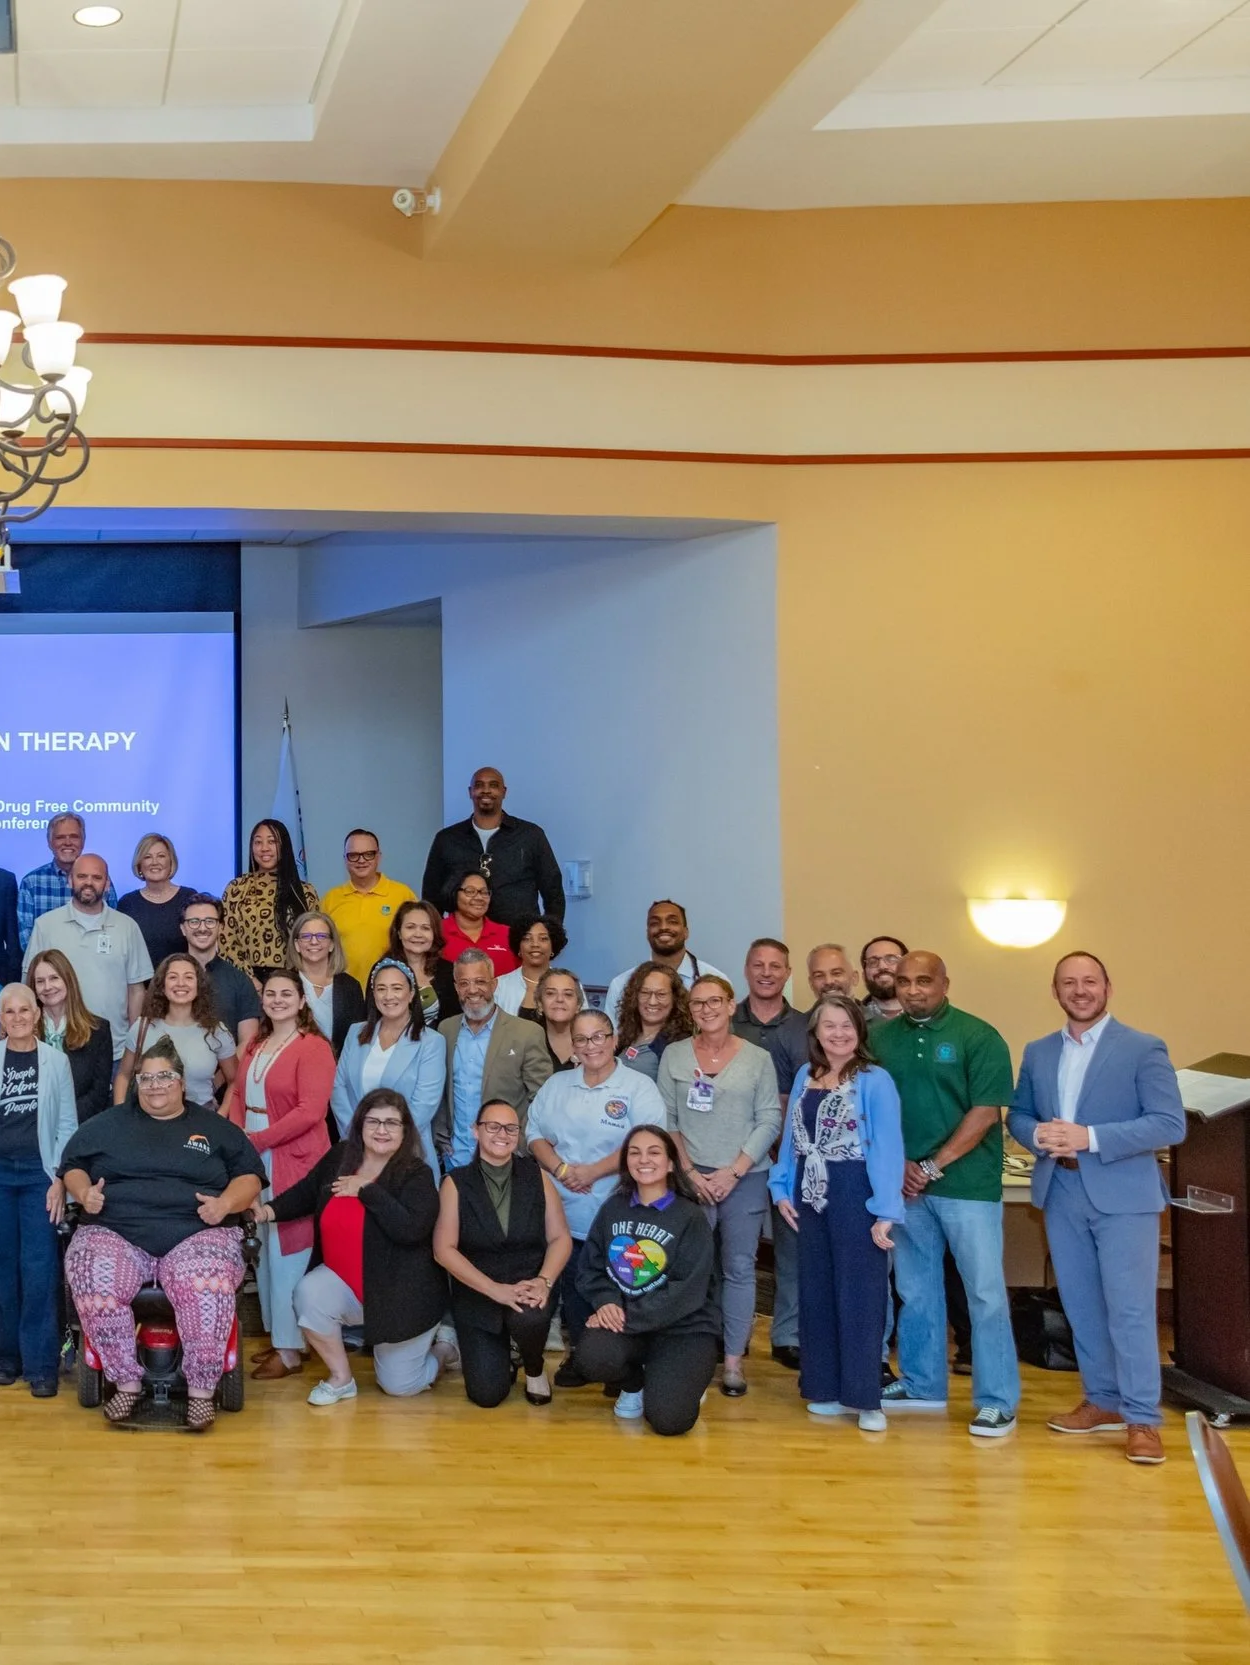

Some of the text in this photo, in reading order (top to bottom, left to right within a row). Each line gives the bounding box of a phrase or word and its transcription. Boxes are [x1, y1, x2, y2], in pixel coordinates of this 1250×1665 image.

[18, 731, 137, 751] THERAPY
[35, 800, 69, 813] Free
[73, 800, 160, 815] Community
[7, 1066, 36, 1084] People
[4, 1099, 38, 1116] People
[612, 1221, 675, 1246] ONE HEART
